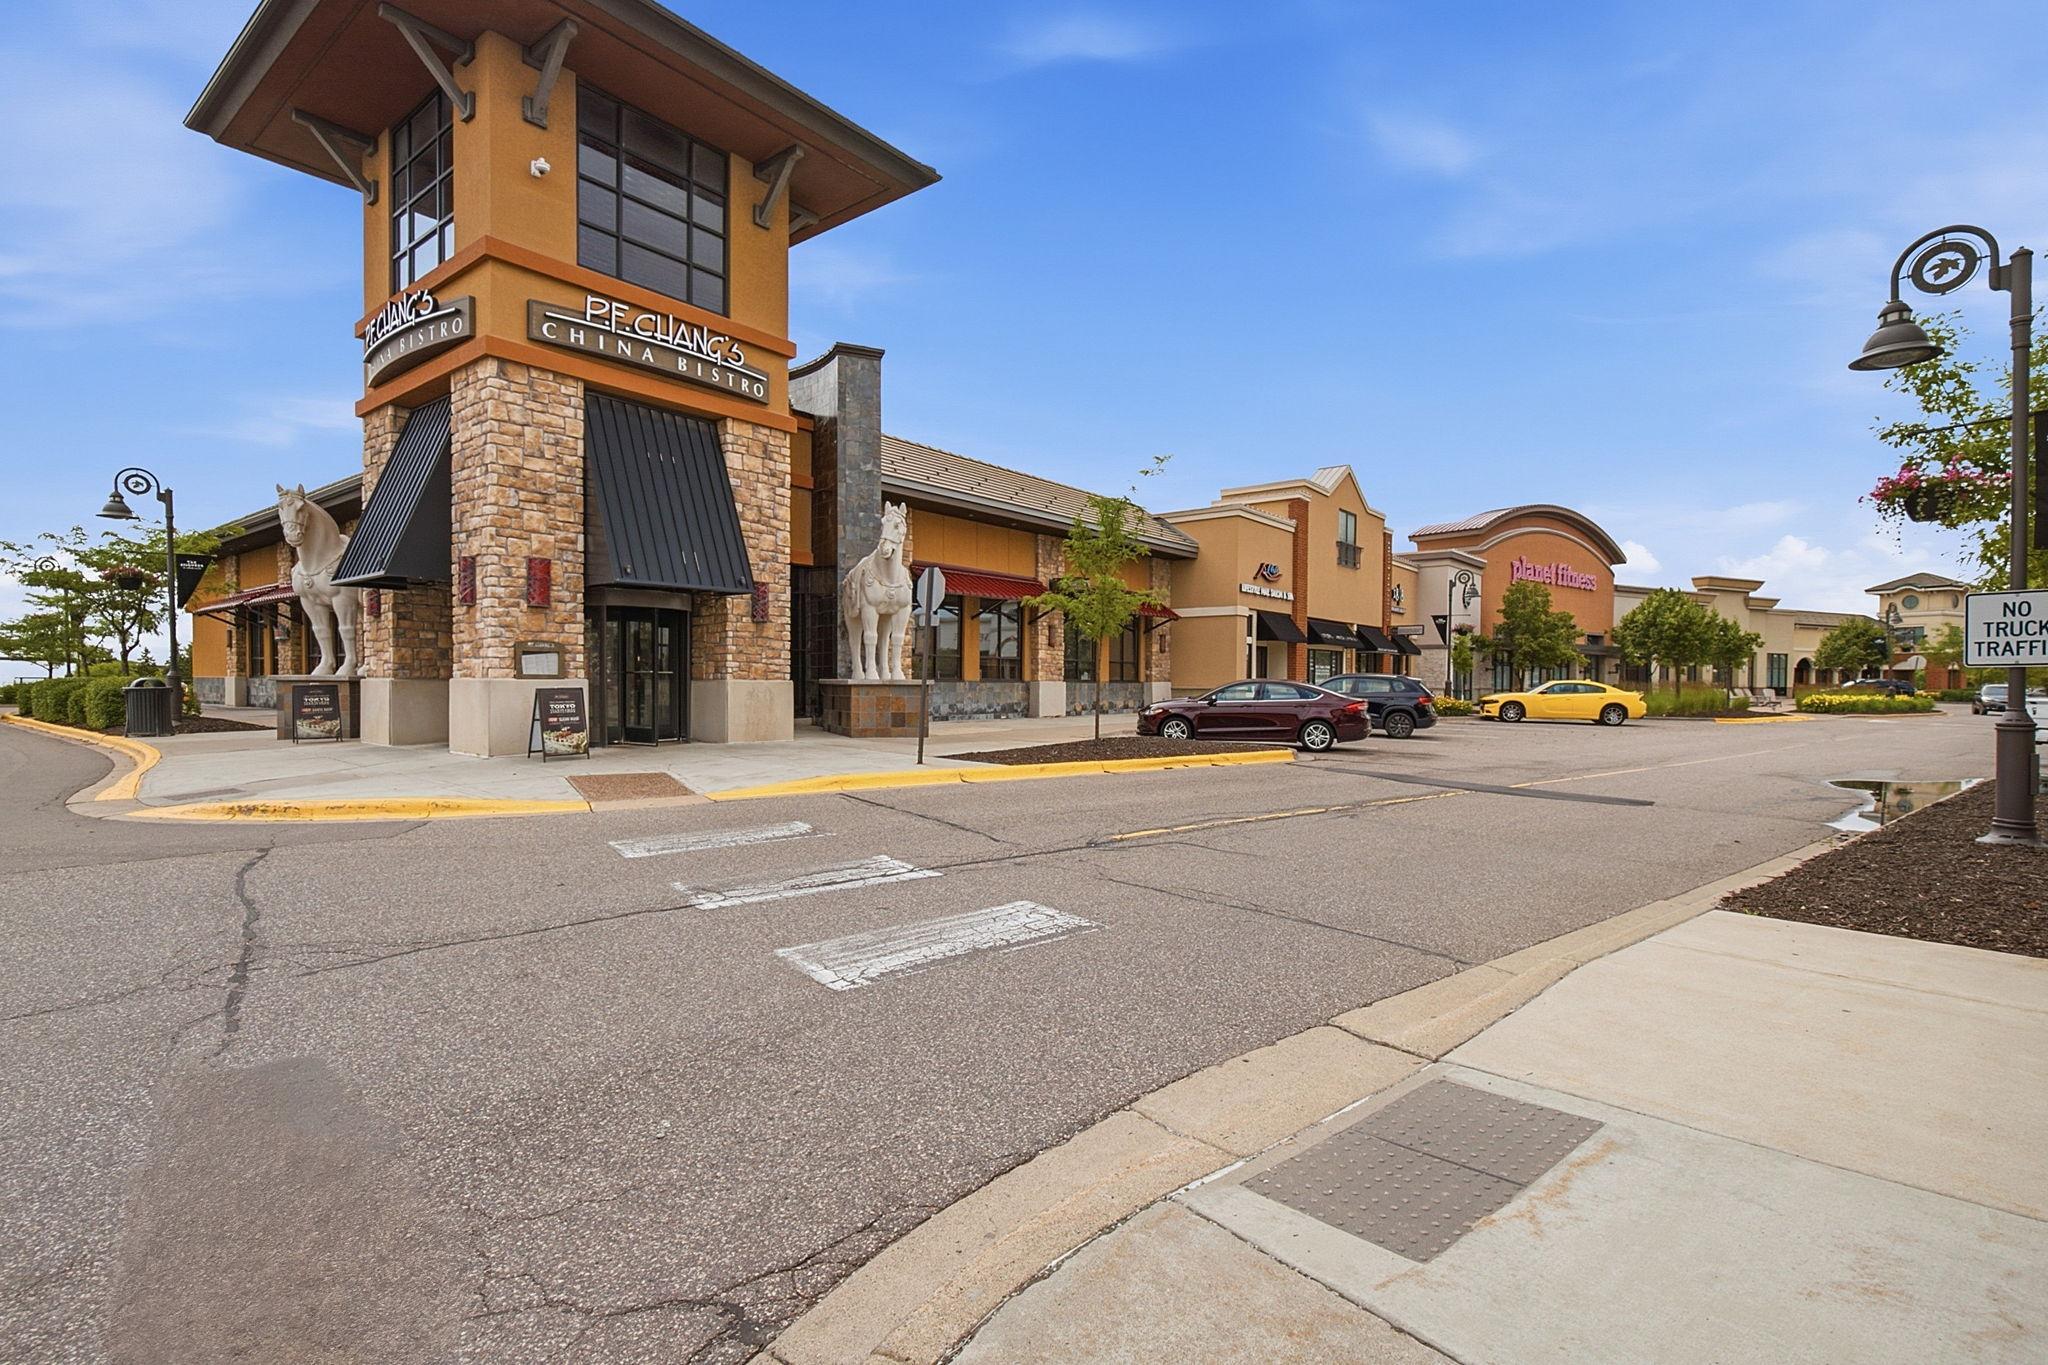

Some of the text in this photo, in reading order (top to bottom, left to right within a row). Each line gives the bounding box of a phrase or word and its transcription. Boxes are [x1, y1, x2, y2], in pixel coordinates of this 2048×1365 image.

[400, 317, 463, 353] BISTRO
[542, 322, 765, 398] CHINA BISTRO
[1510, 555, 1598, 592] planet fitness
[2003, 600, 2032, 618] NO
[1982, 619, 2048, 638] TRUCK
[1974, 639, 2047, 657] TRAFFI
